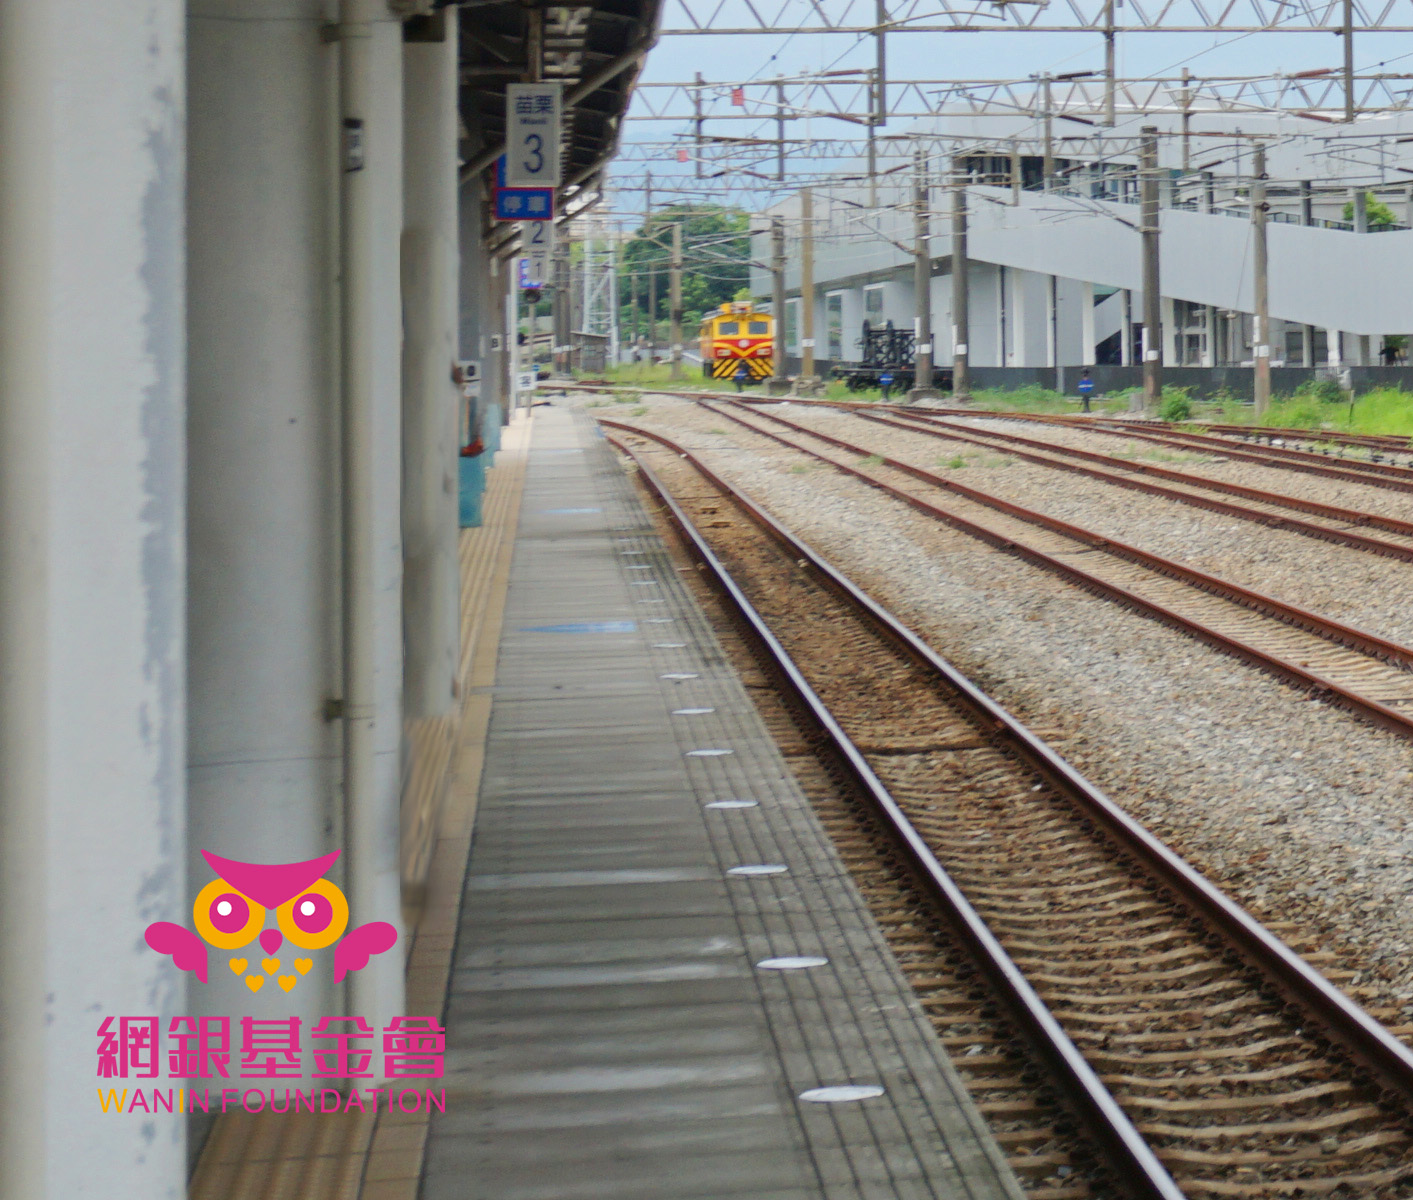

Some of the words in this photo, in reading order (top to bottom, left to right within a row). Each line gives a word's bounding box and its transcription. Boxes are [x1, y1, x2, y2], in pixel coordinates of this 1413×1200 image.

[516, 96, 553, 114] 苗栗
[525, 134, 543, 173] 3
[531, 221, 546, 243] 2
